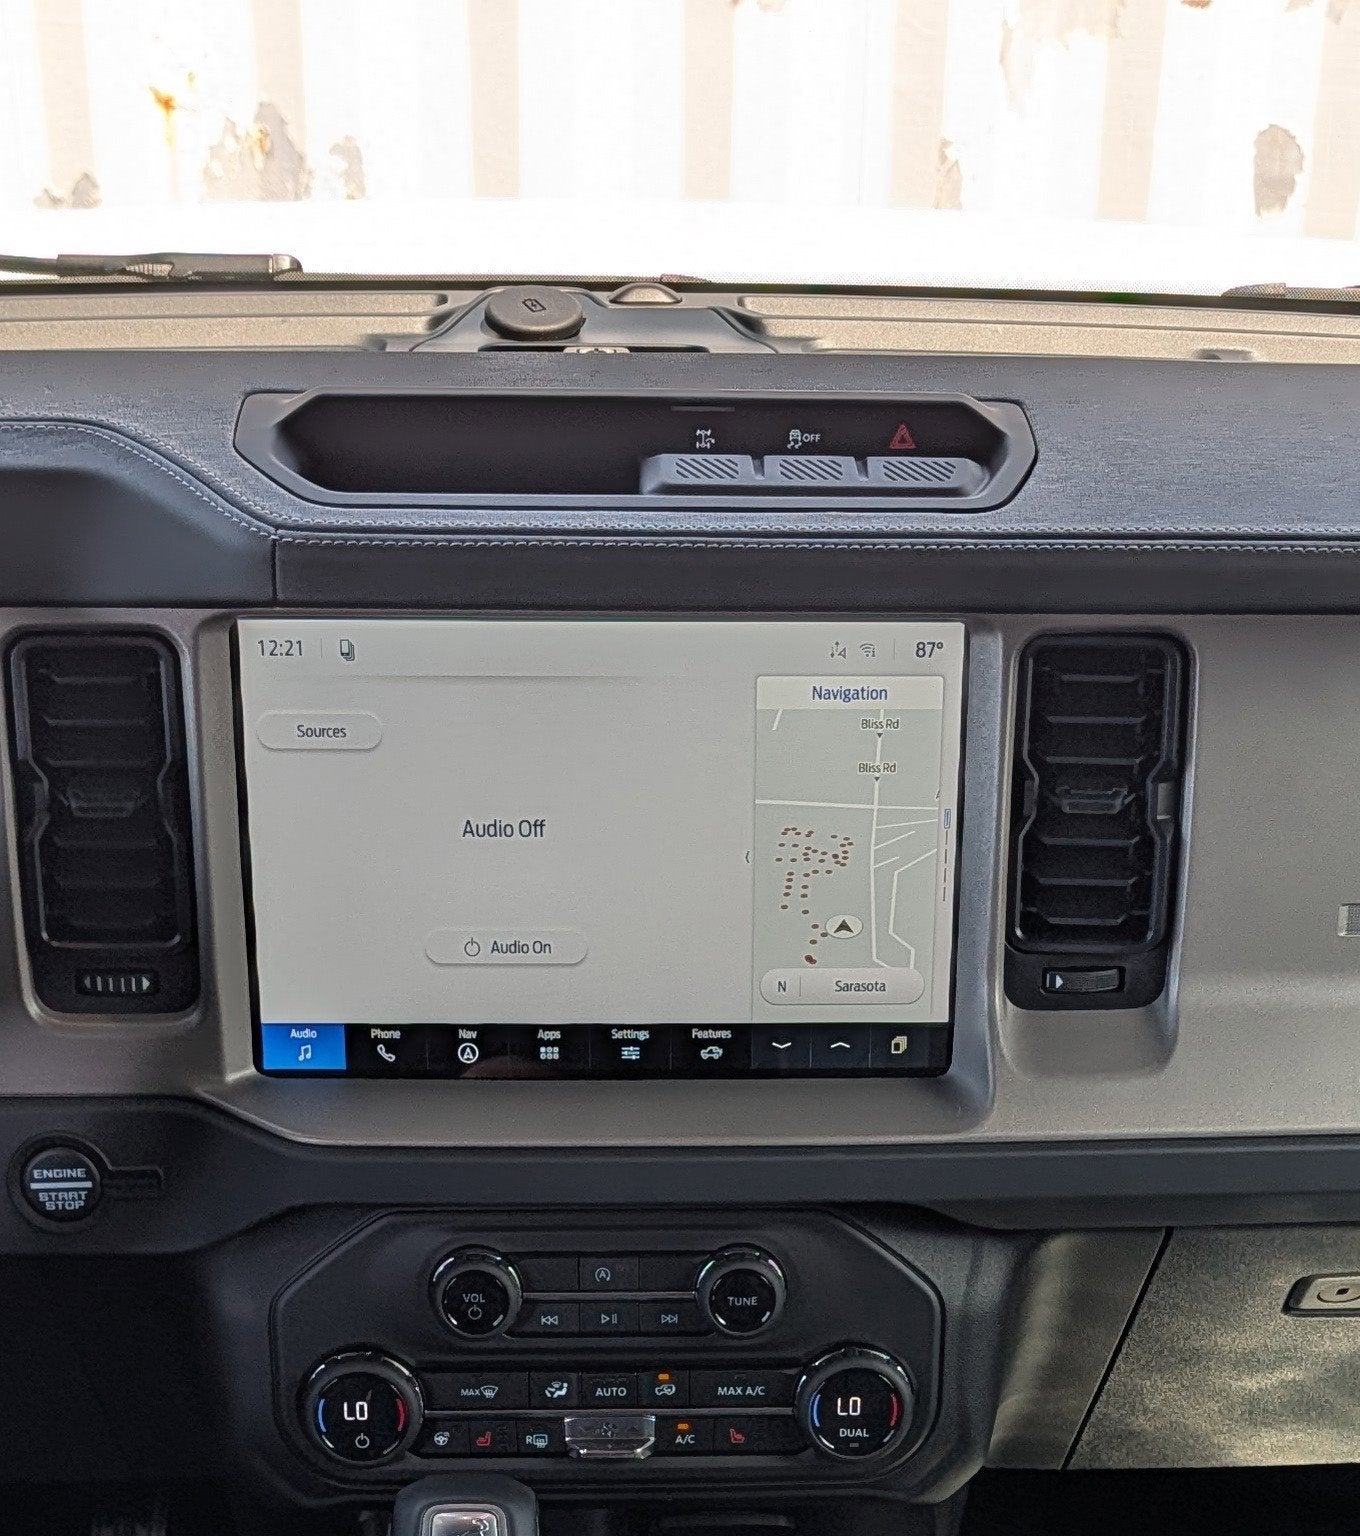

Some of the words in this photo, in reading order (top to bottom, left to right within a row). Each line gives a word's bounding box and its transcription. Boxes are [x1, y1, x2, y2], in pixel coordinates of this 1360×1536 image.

[803, 432, 821, 443] OFF
[257, 640, 304, 658] 12:21
[915, 641, 944, 659] 87°
[812, 685, 888, 703] Navigation
[861, 718, 883, 730] Bliss
[885, 718, 900, 730] Rd
[296, 724, 347, 739] Sources
[858, 762, 881, 774] Bliss
[883, 762, 897, 774] Rd
[462, 818, 513, 839] Audio
[519, 818, 546, 839] Off
[490, 940, 531, 957] Audio
[534, 940, 552, 957] On
[777, 980, 787, 994] N
[834, 979, 887, 993] Sarasota
[290, 1028, 317, 1040] Audio
[370, 1028, 401, 1040] Phone
[458, 1028, 477, 1040] Nav
[537, 1028, 561, 1042] Apps
[611, 1028, 650, 1042] Settings
[691, 1028, 732, 1040] Features
[33, 1168, 87, 1179] ENGINE
[38, 1191, 88, 1202] START
[45, 1200, 85, 1211] STOP
[462, 1292, 486, 1305] VOL
[727, 1295, 758, 1308] TUNE
[461, 1388, 481, 1397] MAX
[595, 1387, 627, 1397] AUTO
[717, 1386, 742, 1397] MAX
[745, 1385, 766, 1398] A/C
[343, 1401, 368, 1421] LO
[836, 1396, 862, 1416] LO
[838, 1427, 870, 1438] DUAL
[675, 1435, 696, 1446] A/C
